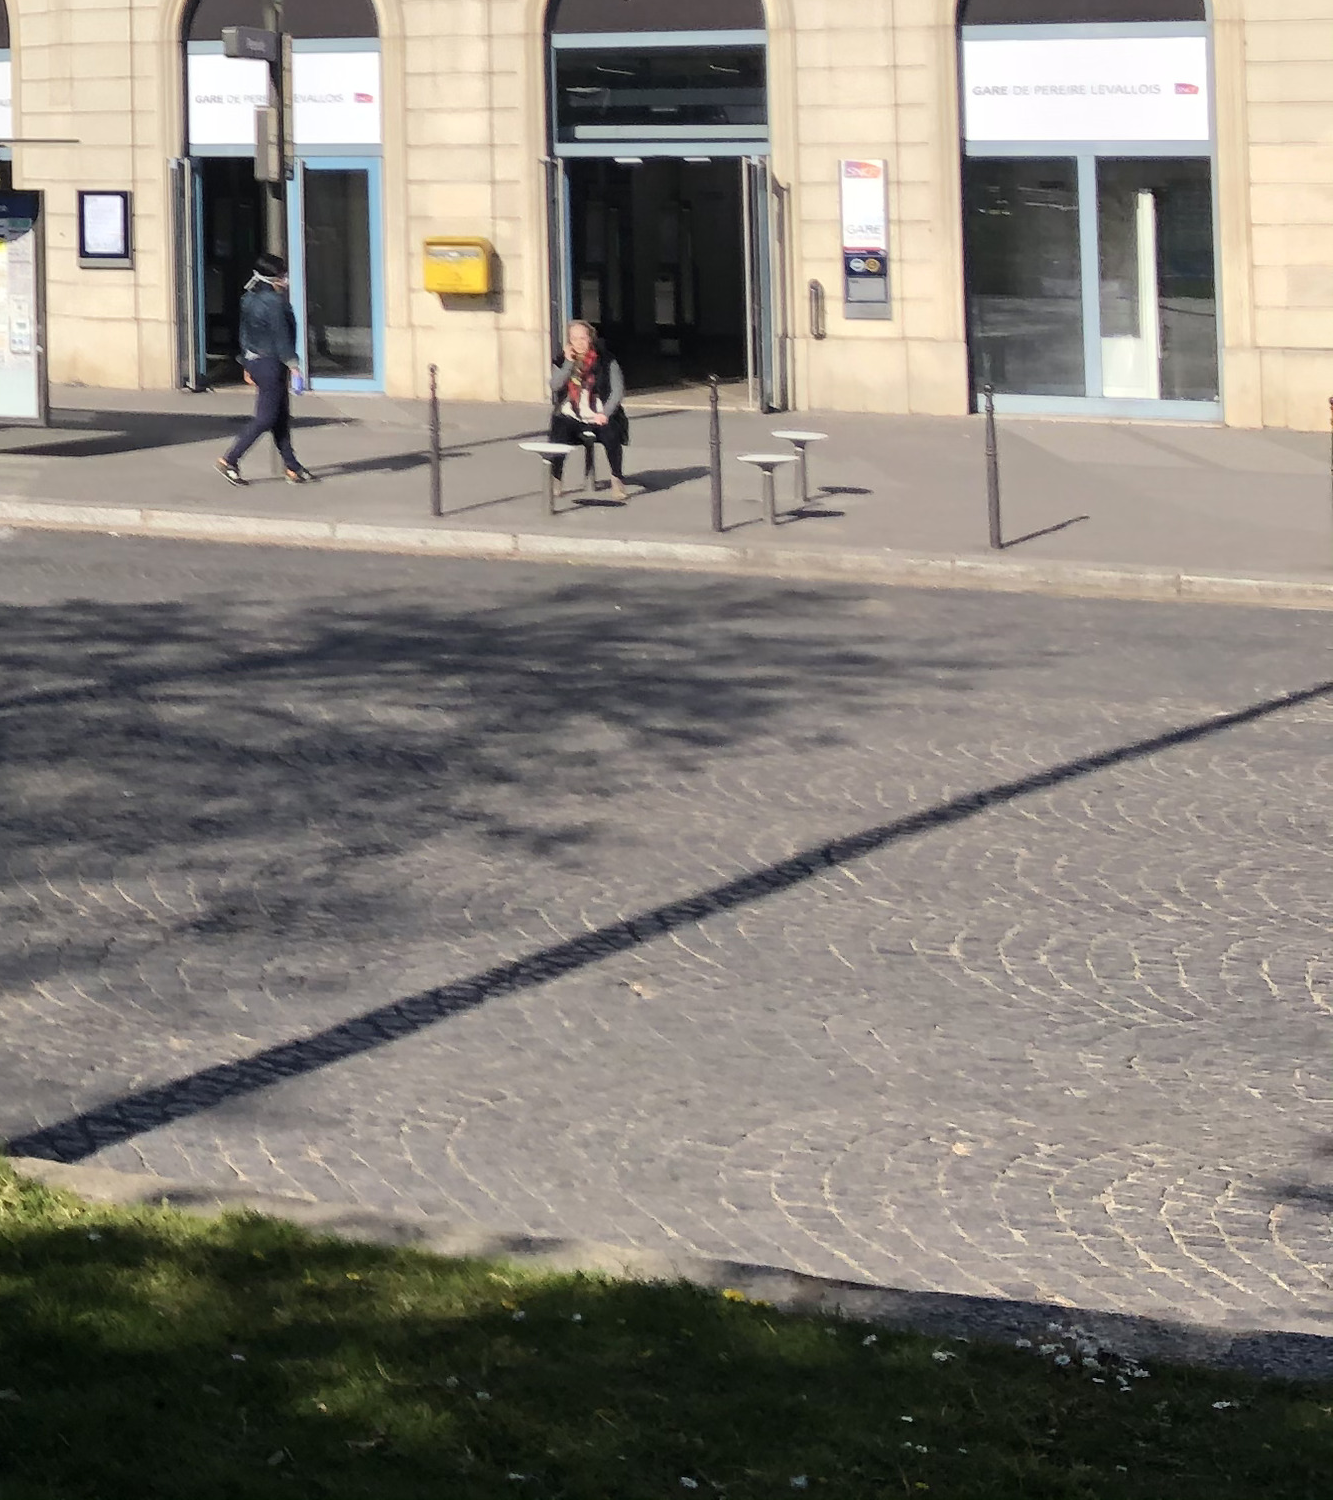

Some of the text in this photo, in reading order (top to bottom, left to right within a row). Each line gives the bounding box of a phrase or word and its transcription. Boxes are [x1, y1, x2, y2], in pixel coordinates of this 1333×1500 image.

[973, 84, 1162, 96] GARE DE PEREIRE LEVALLOIS
[195, 94, 224, 104] GARE
[227, 94, 241, 104] DE
[293, 93, 344, 104] EVALLOIS
[847, 224, 882, 235] GARE
